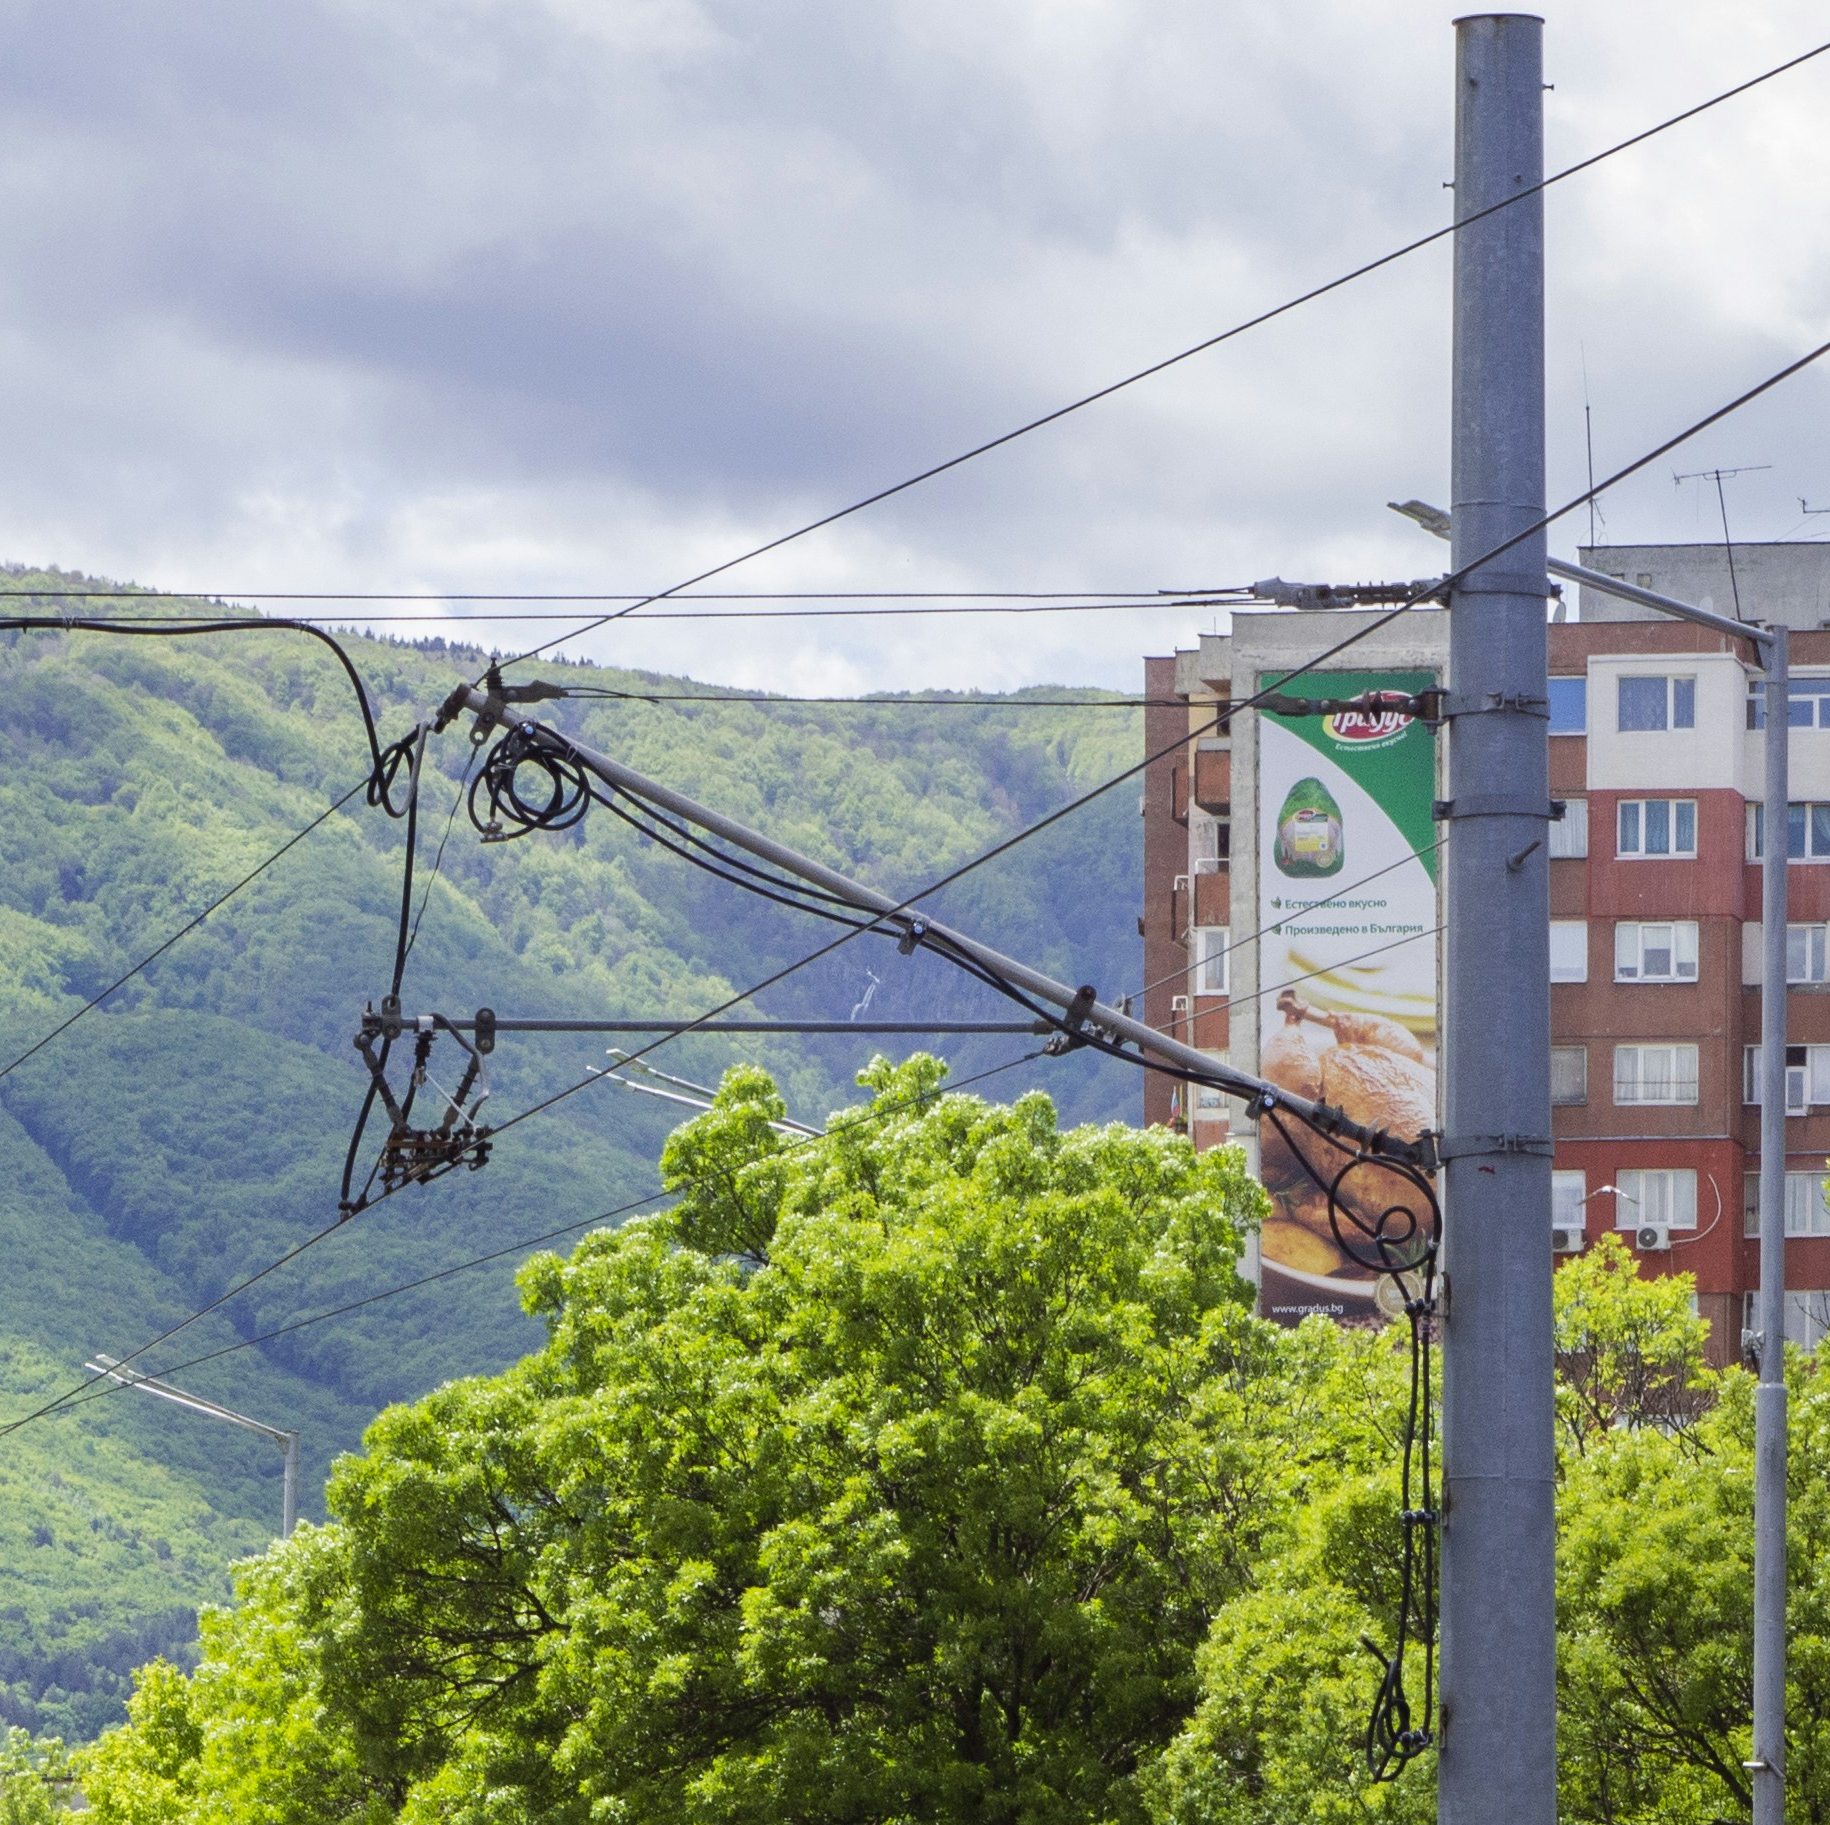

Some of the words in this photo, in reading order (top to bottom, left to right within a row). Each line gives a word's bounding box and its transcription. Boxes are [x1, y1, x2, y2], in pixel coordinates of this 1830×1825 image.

[1285, 899, 1347, 910] Естествено
[1349, 899, 1387, 911] вкусно
[1285, 925, 1359, 937] Произведено
[1361, 926, 1368, 934] в
[1370, 923, 1423, 937] България
[1271, 1303, 1344, 1316] www.gradus.bg
